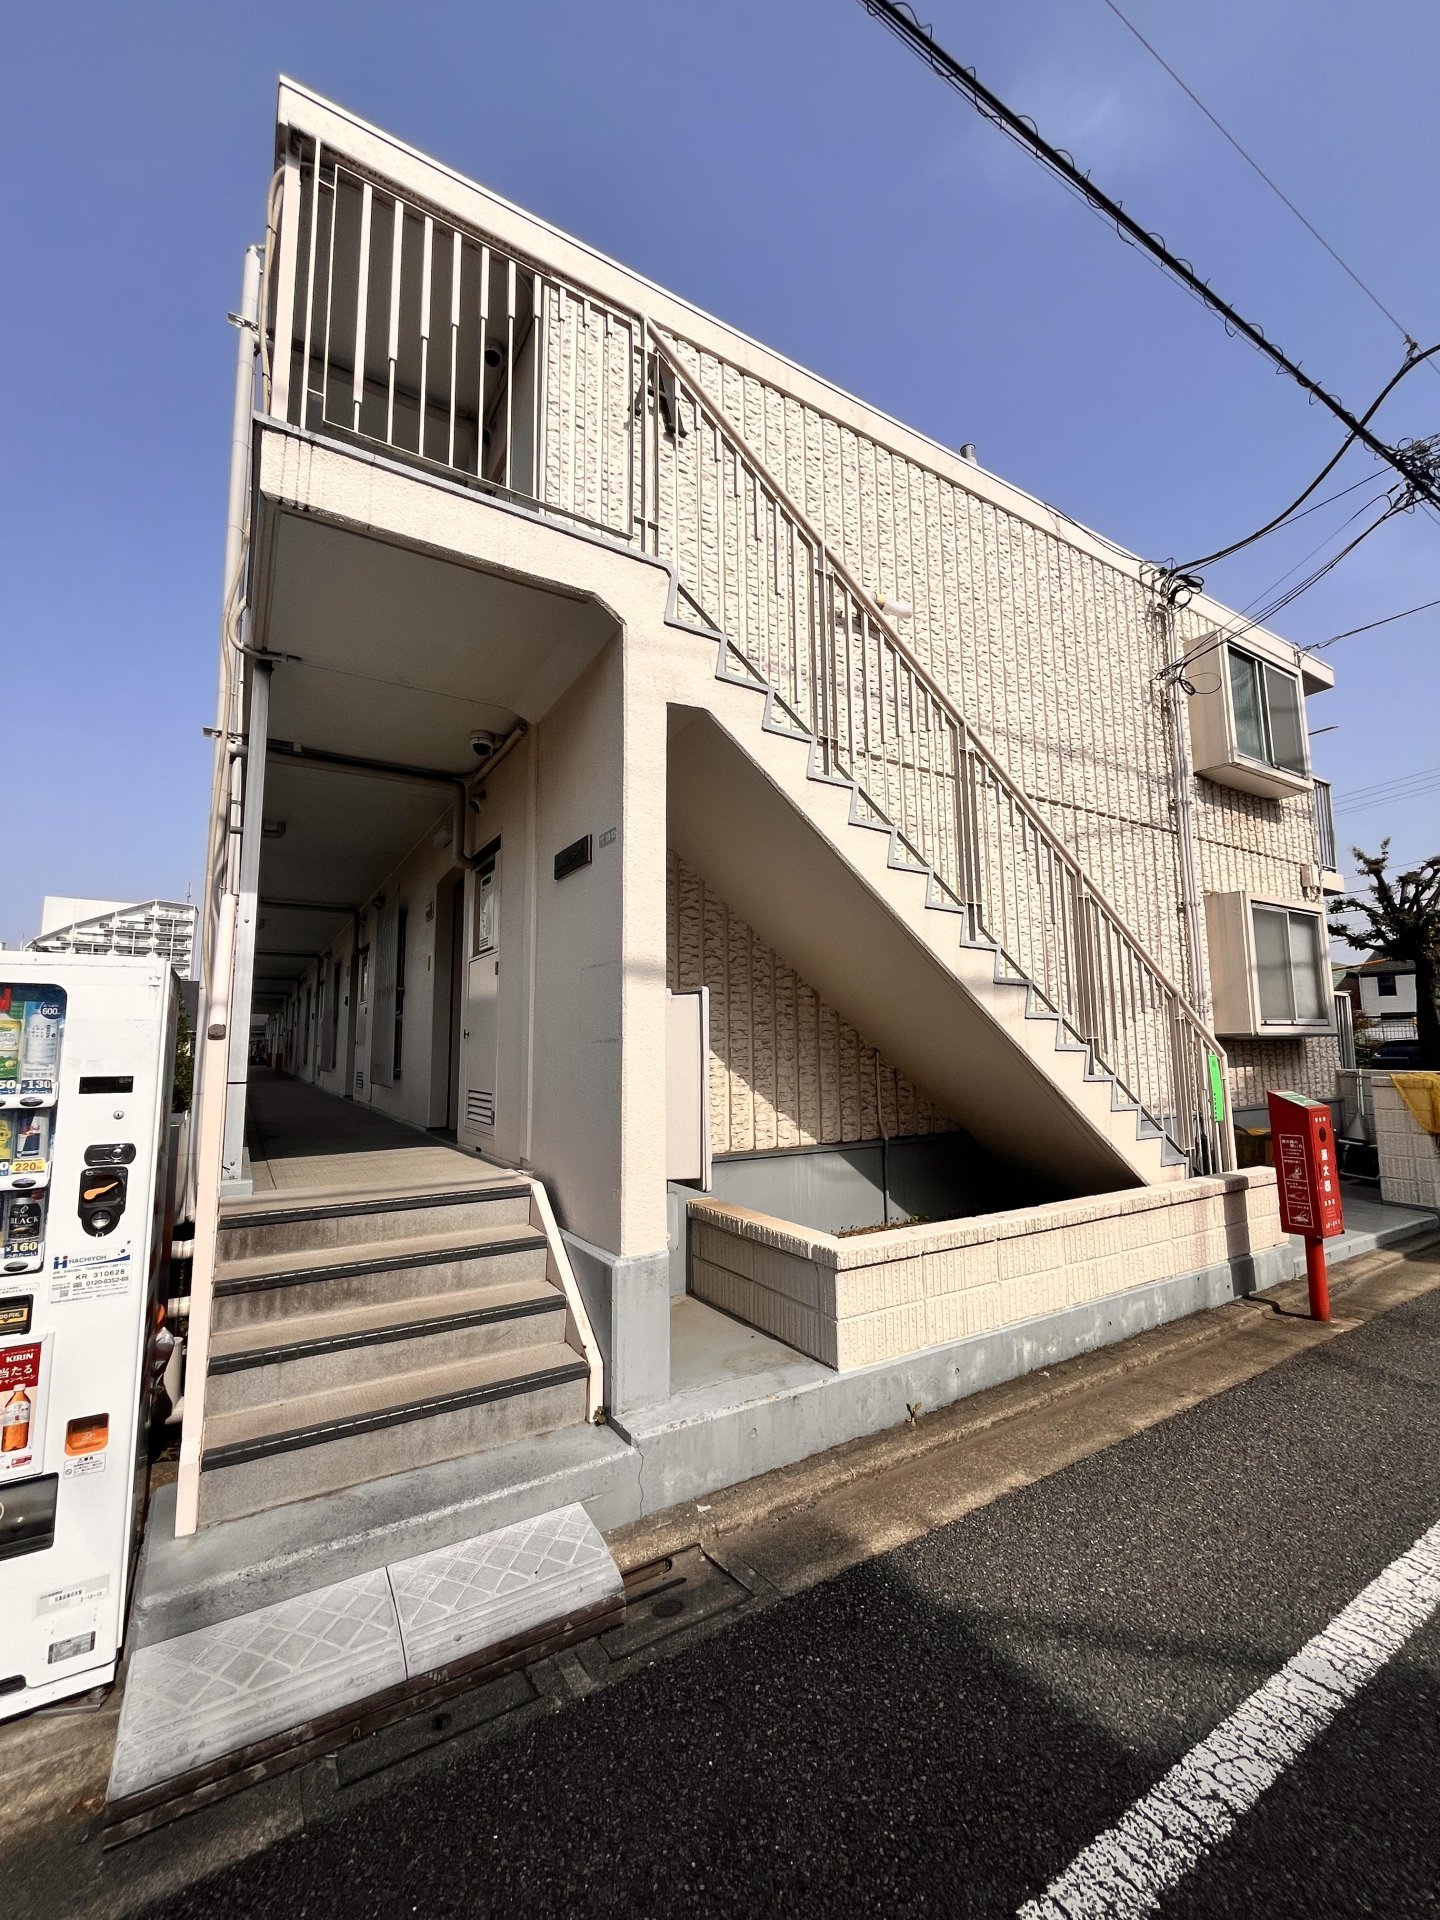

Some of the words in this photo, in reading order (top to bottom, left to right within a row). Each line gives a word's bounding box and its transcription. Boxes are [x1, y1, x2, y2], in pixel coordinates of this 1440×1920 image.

[42, 1007, 58, 1015] 600
[11, 1216, 39, 1225] BLACK
[93, 1269, 125, 1278] 310628
[6, 1353, 33, 1363] KIRIN
